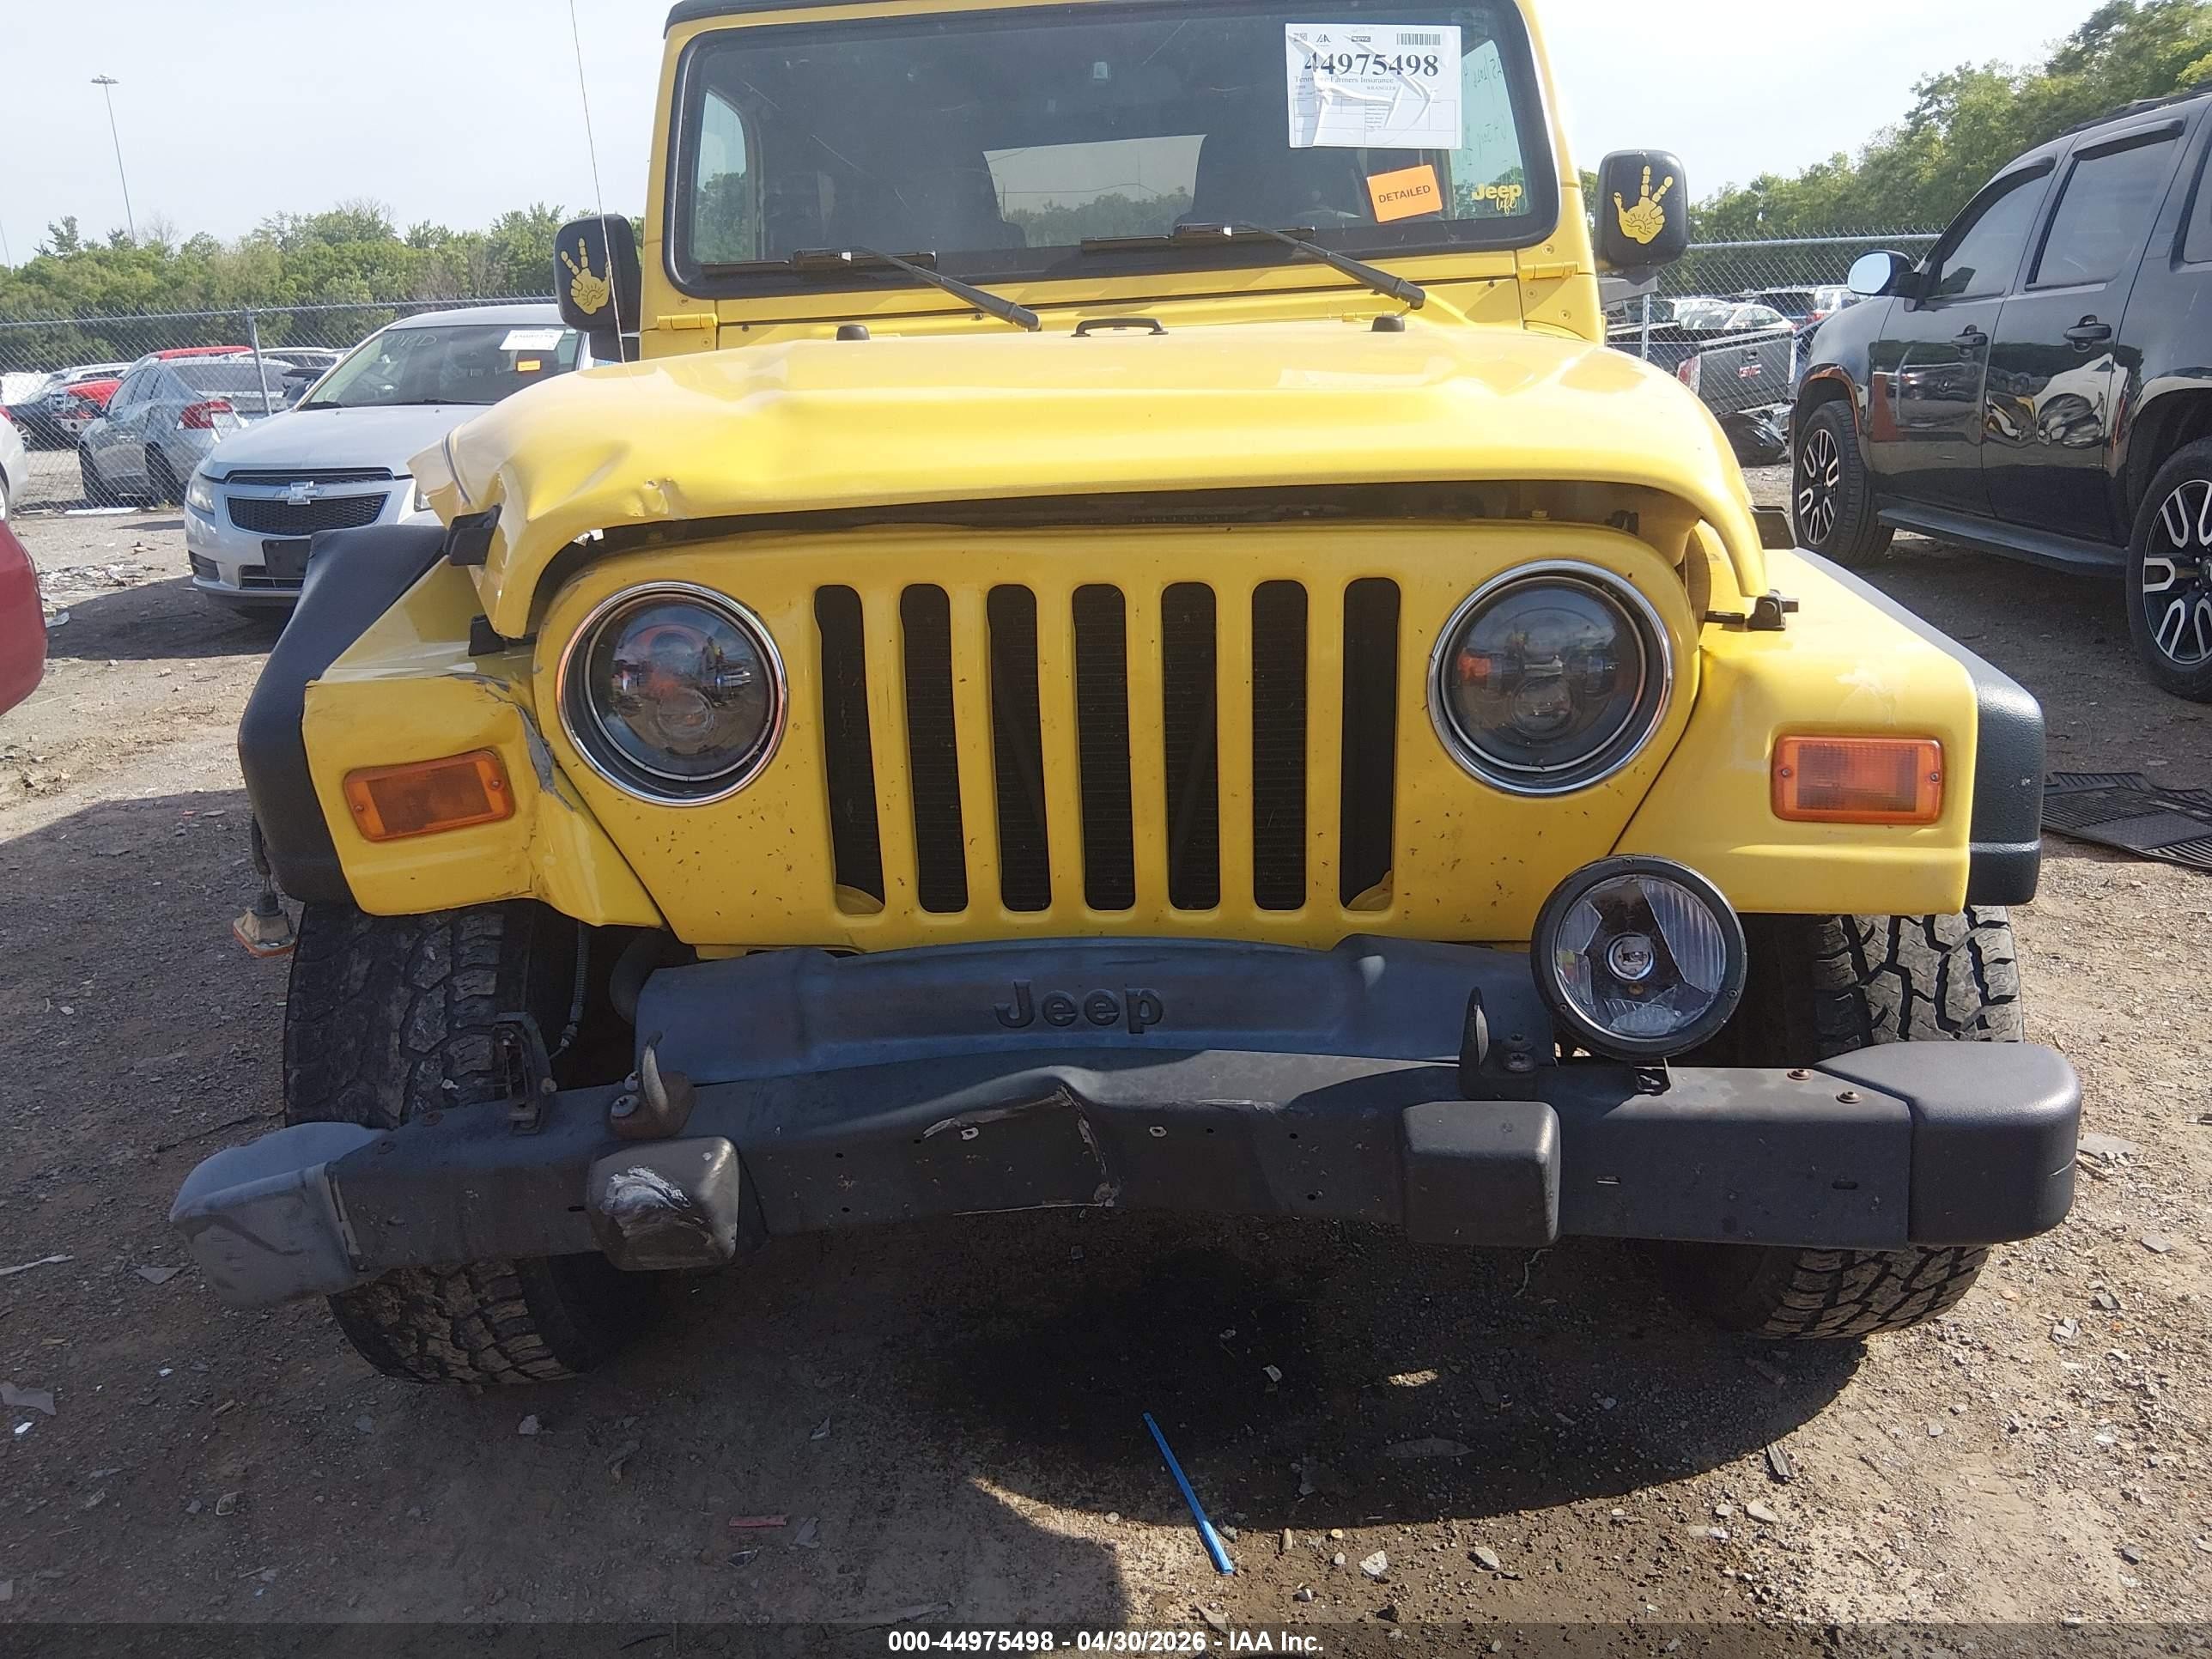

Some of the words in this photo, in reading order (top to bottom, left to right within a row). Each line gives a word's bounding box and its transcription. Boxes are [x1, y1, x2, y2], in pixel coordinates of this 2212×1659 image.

[1304, 52, 1438, 76] 44975498
[1378, 184, 1431, 204] DETAILED
[1471, 183, 1522, 201] Jeep
[994, 979, 1164, 1035] Jeep
